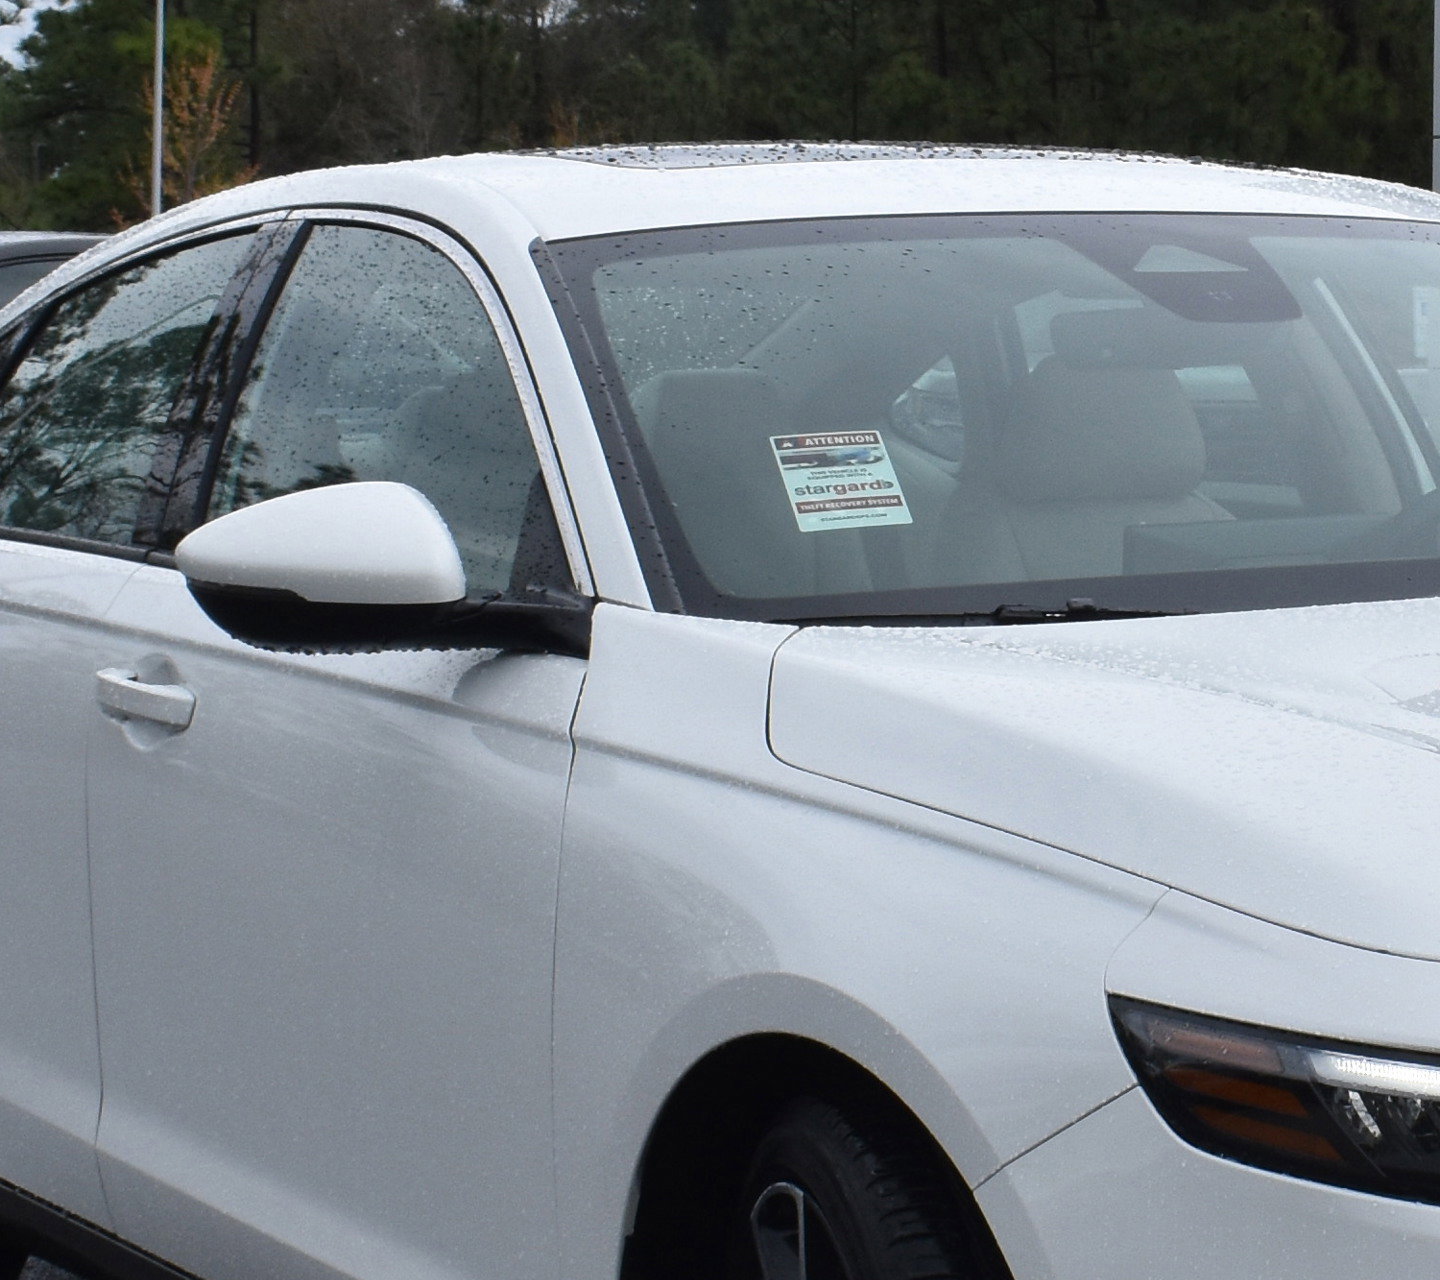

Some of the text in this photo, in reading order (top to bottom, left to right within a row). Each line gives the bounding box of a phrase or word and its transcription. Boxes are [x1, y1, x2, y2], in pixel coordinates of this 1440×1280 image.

[805, 434, 875, 447] ATTENTION
[800, 498, 899, 511] THEFT RECOVERY SYSTEM
